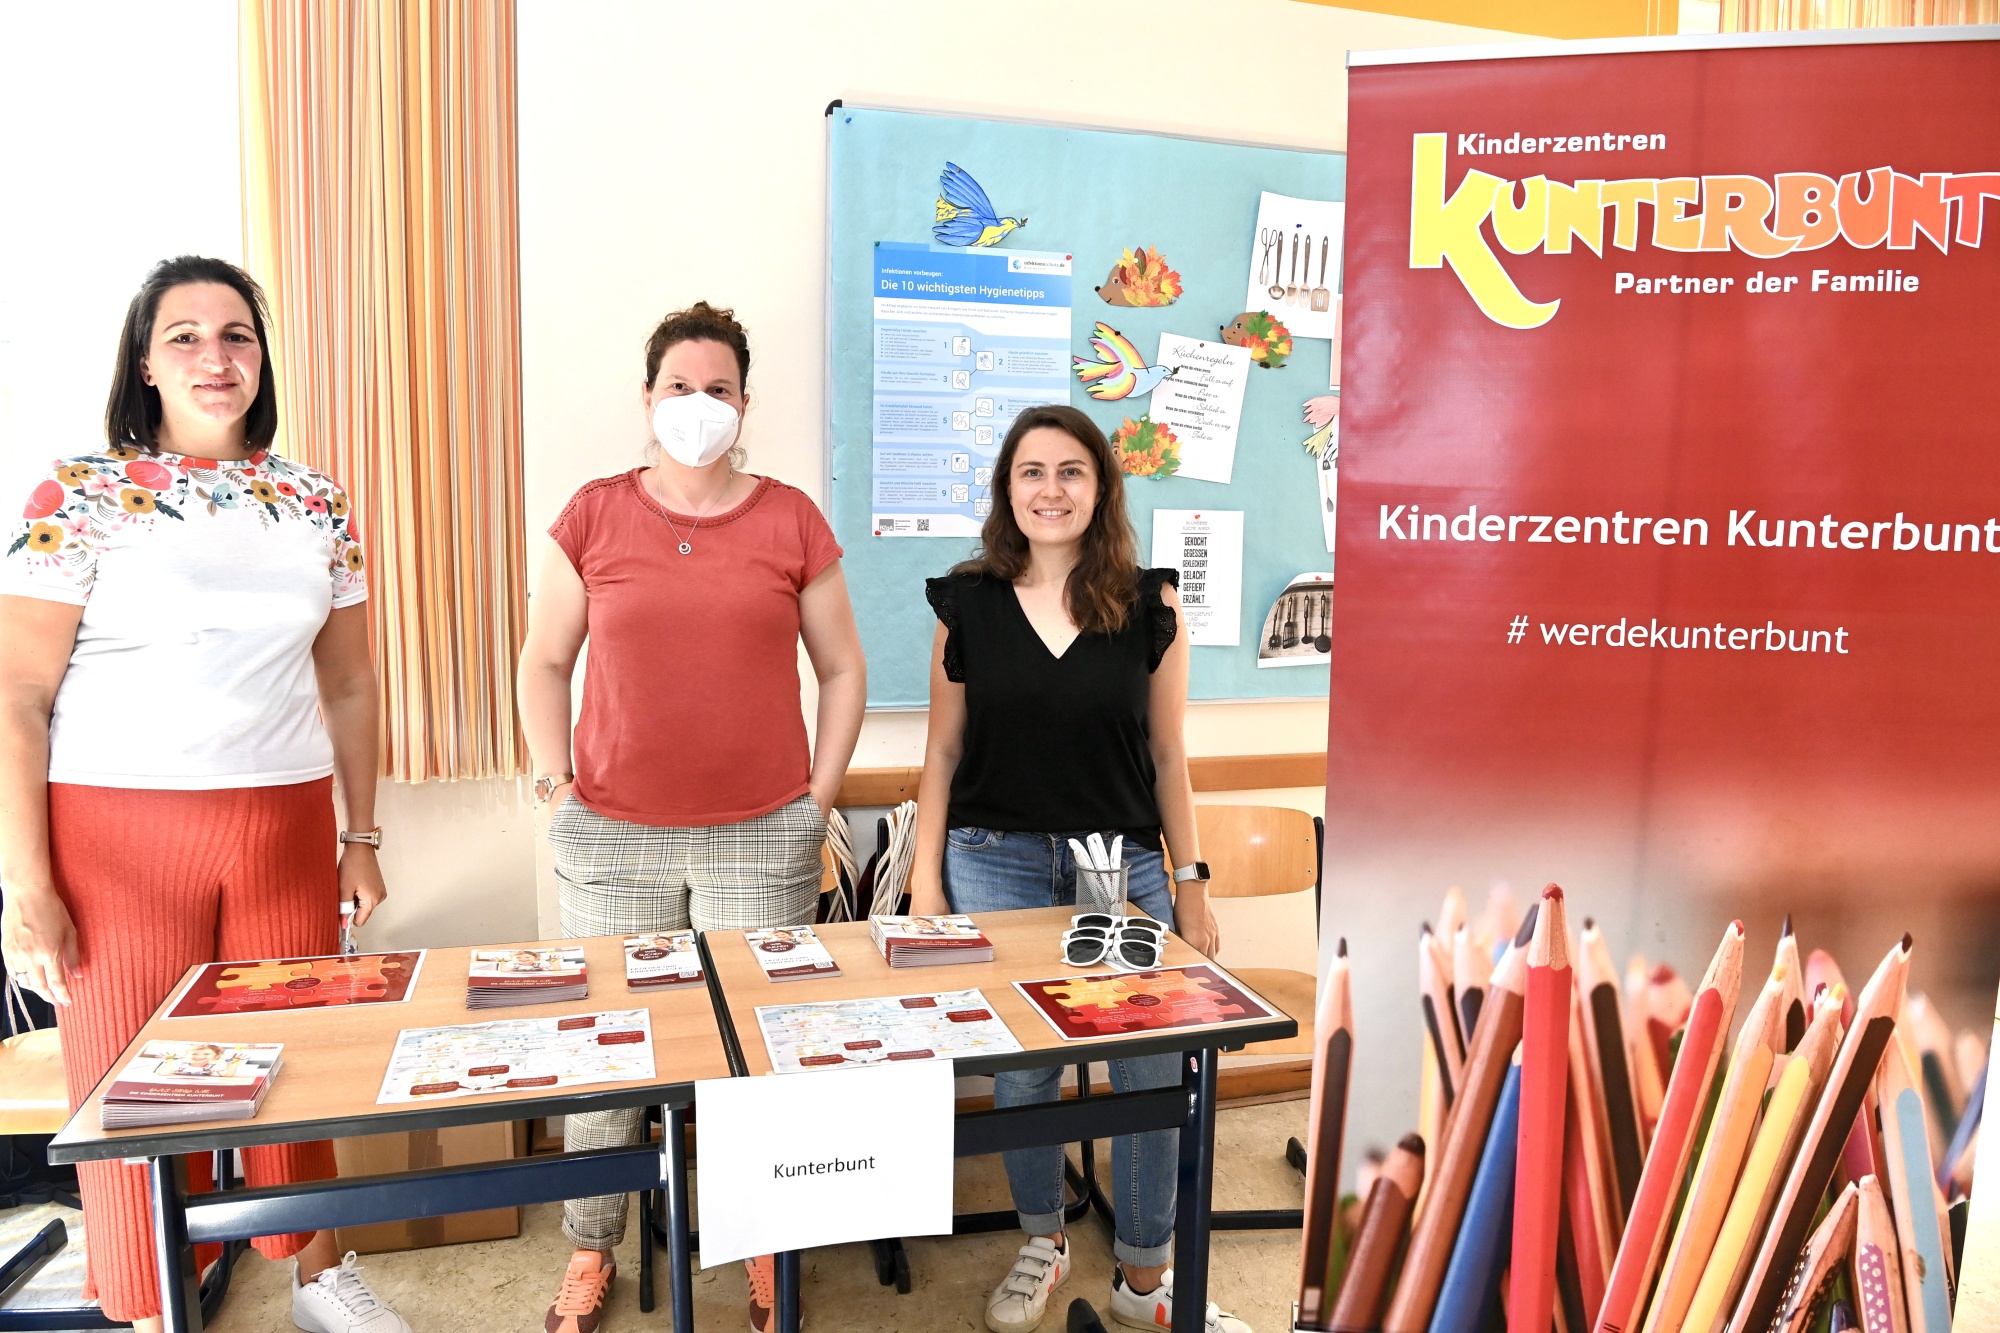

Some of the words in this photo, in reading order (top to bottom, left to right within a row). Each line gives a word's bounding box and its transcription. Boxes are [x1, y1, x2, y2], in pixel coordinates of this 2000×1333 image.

[1457, 132, 1667, 156] Kinderzentren
[1409, 132, 2000, 330] KUNTERBUNT
[881, 267, 913, 276] Infektionen
[913, 269, 944, 278] vorbeugen:
[1614, 272, 1734, 294] Partner
[1746, 271, 1798, 293] der
[1811, 269, 1920, 292] Familie
[881, 279, 899, 291] Die
[901, 280, 915, 291] 10
[917, 282, 977, 296] wichtigsten
[979, 285, 1045, 300] Hygienetipps
[1172, 345, 1235, 367] Küchenregeln
[998, 358, 1003, 366] 2
[943, 375, 948, 383] 3
[942, 416, 948, 424] 5
[941, 489, 947, 497] 9
[1379, 504, 1709, 545] Kinderzentren
[1727, 509, 2000, 553] Kunterbunt
[1184, 536, 1207, 546] GEKOCHT
[1183, 549, 1208, 558] GEGESSEN
[1183, 570, 1206, 580] GELACHT
[1182, 582, 1206, 592] GEFEIERT
[1182, 593, 1205, 604] ERZÄHLT
[1507, 615, 1530, 644] #
[1539, 617, 1849, 654] werdekunterbunt
[774, 1156, 876, 1179] Kunterbunt
